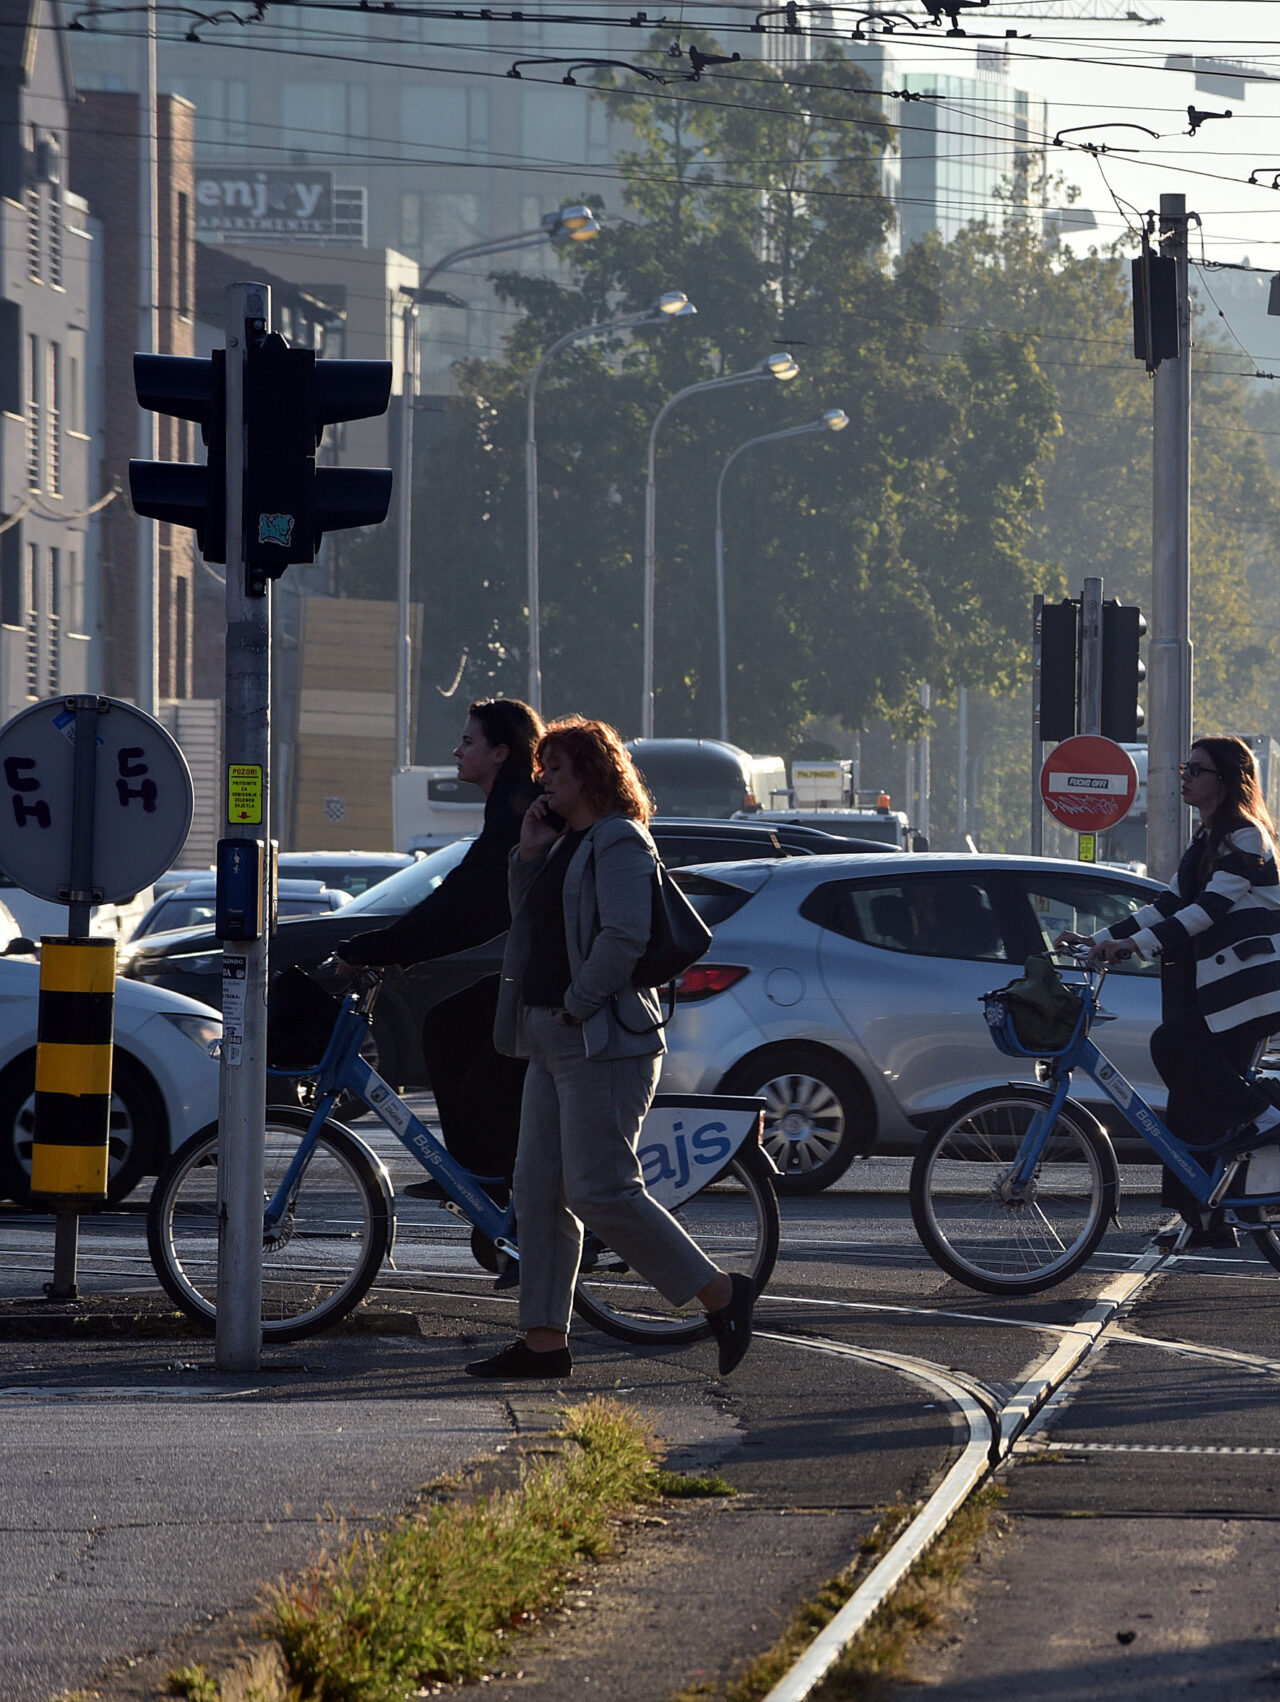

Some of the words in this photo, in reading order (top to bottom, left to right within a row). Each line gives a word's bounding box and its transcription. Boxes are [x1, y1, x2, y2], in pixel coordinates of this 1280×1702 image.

[198, 217, 323, 232] APARTMENTS
[1135, 1109, 1161, 1137] Bajs
[412, 1134, 442, 1165] Bajs
[636, 1121, 731, 1189] ajs
